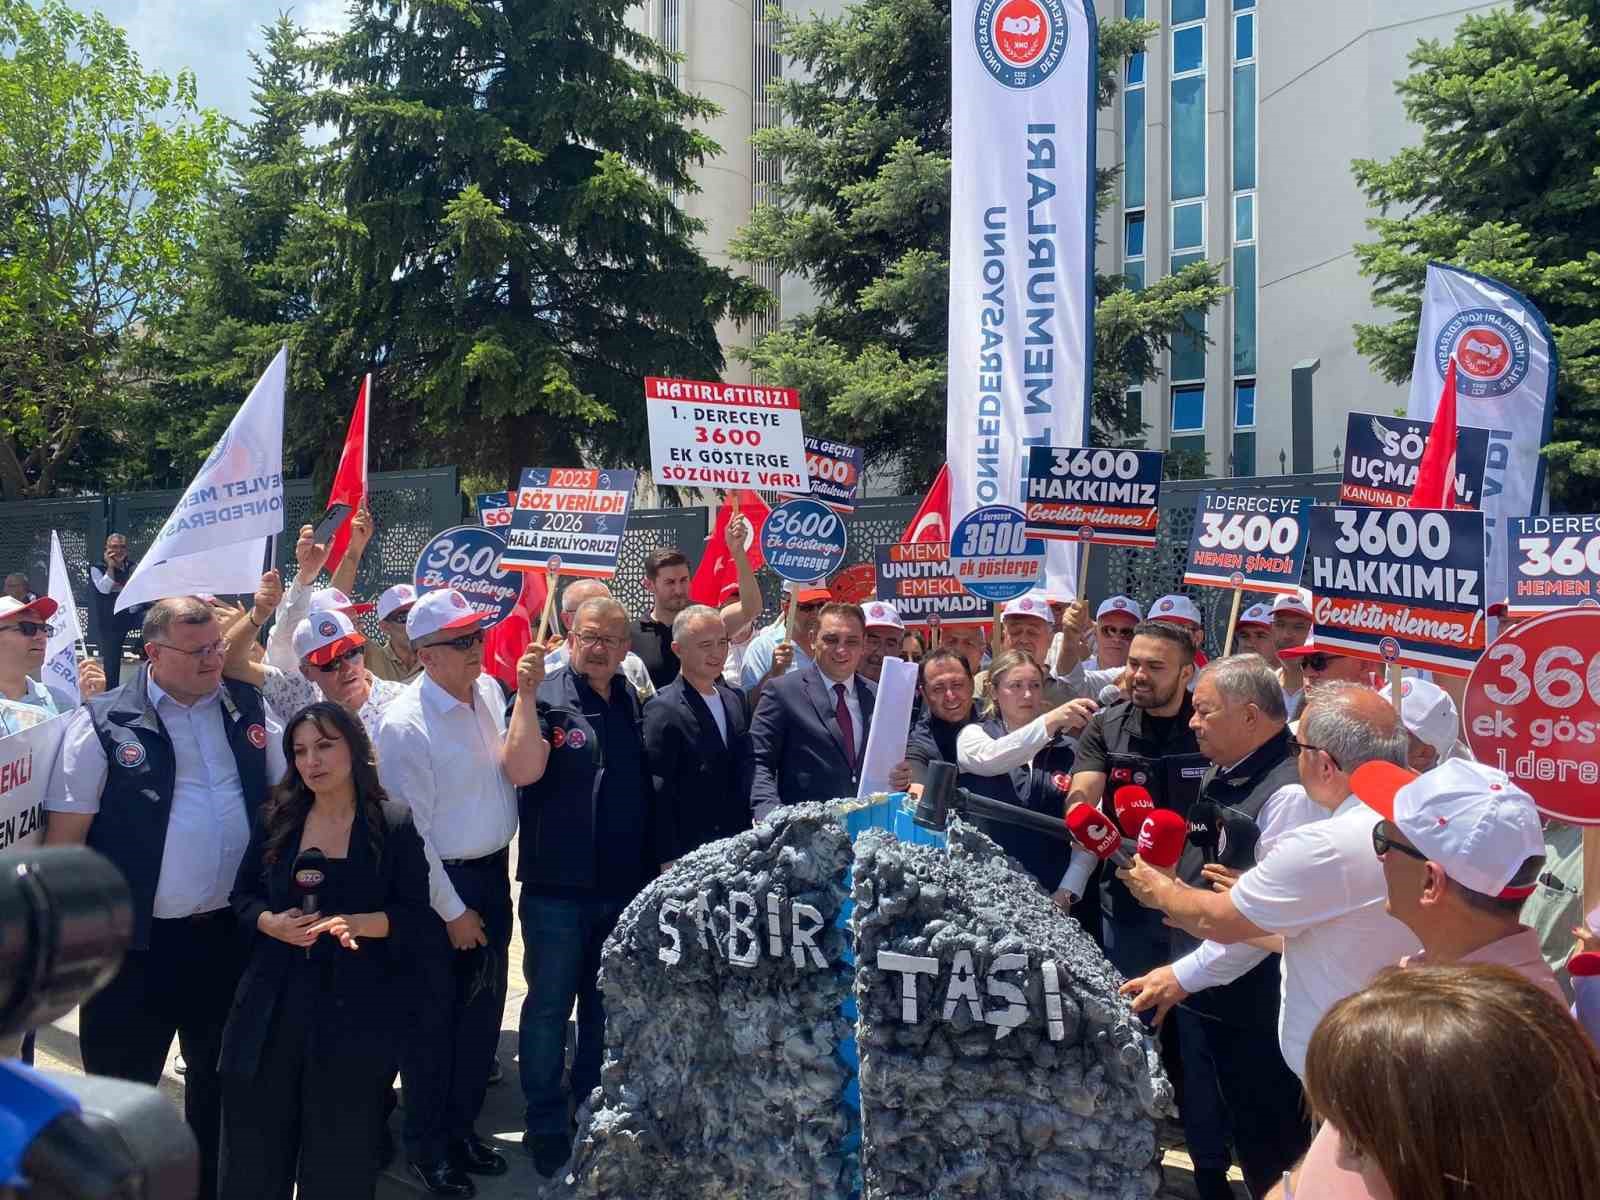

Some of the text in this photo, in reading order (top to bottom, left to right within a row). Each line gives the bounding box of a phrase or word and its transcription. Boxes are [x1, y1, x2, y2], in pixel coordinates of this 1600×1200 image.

[694, 408, 780, 426] DERECEYE
[694, 426, 762, 446] 3600
[1383, 427, 1429, 460] SÖ
[670, 448, 790, 468] EK GÖSTERGE
[805, 455, 848, 483] 600
[1050, 448, 1139, 480] 3600
[553, 470, 592, 488] 2023
[662, 464, 801, 487] SÖZÜNÜZ VAR!
[519, 489, 625, 513] SÖZ VERİLDİ!
[1029, 477, 1156, 504] HAKKIMIZ
[1343, 486, 1393, 506] KANUNA
[486, 508, 512, 525] SÖ
[1205, 495, 1301, 514] 1.DERECEYE
[542, 513, 583, 532] 2026
[768, 509, 837, 538] 3600
[1199, 513, 1299, 554] 3600
[509, 532, 617, 553] HÂLÂ BEKLİYORUZ!
[767, 534, 784, 548] Ek
[962, 521, 1026, 555] 3600
[1334, 510, 1450, 560] 3600
[900, 544, 951, 561] MEMU
[1193, 550, 1243, 569] HEMEN
[1313, 557, 1479, 605] HAKKIMIZ
[1517, 580, 1590, 596] HEMEN
[1315, 597, 1484, 645] Geciktirilemez!
[1472, 710, 1600, 748] ek gös
[0, 748, 32, 795] EKLİ
[658, 890, 829, 969] SABIR
[877, 950, 1065, 1040] TAŞI
